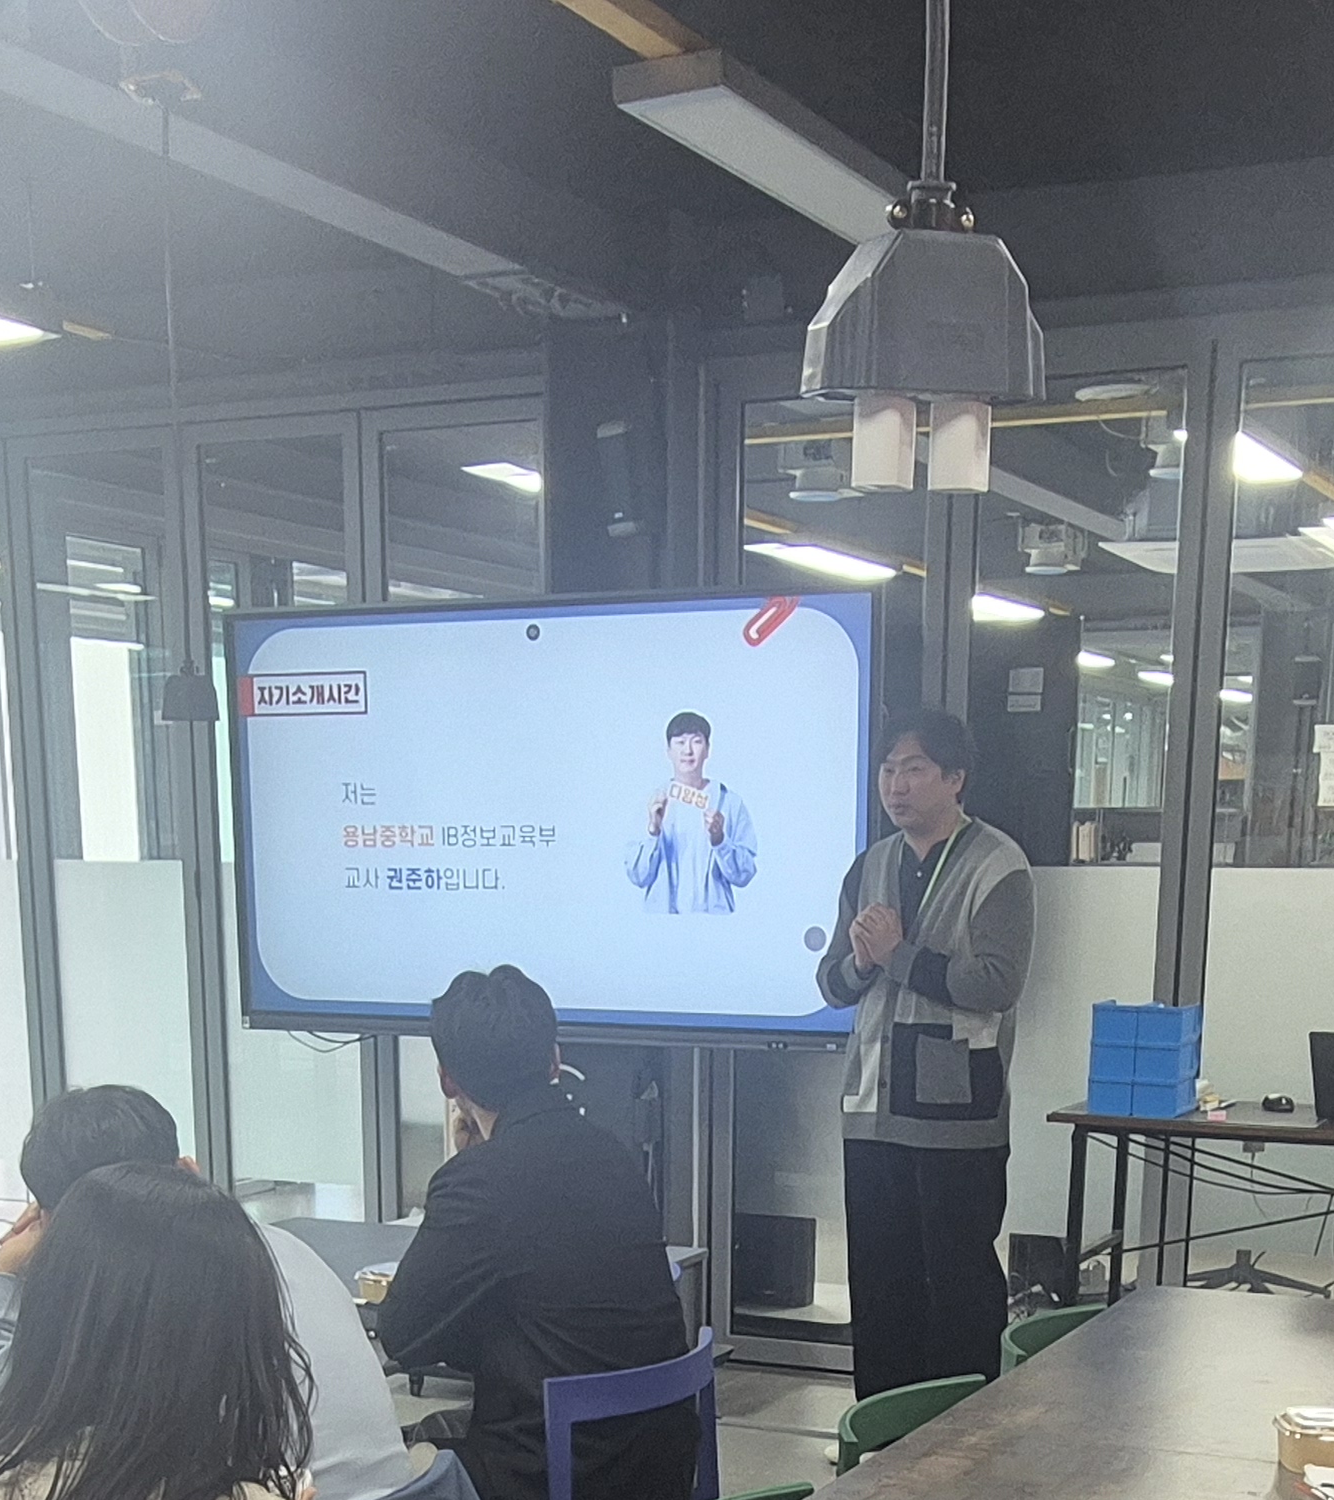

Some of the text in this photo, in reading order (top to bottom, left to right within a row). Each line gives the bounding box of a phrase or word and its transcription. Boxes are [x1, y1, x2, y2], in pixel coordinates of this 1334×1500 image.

[257, 682, 360, 706] 자기소개시간
[342, 782, 376, 805] 저는
[343, 825, 556, 848] 용남중학교 IB정보교육부
[345, 867, 379, 889] 교사
